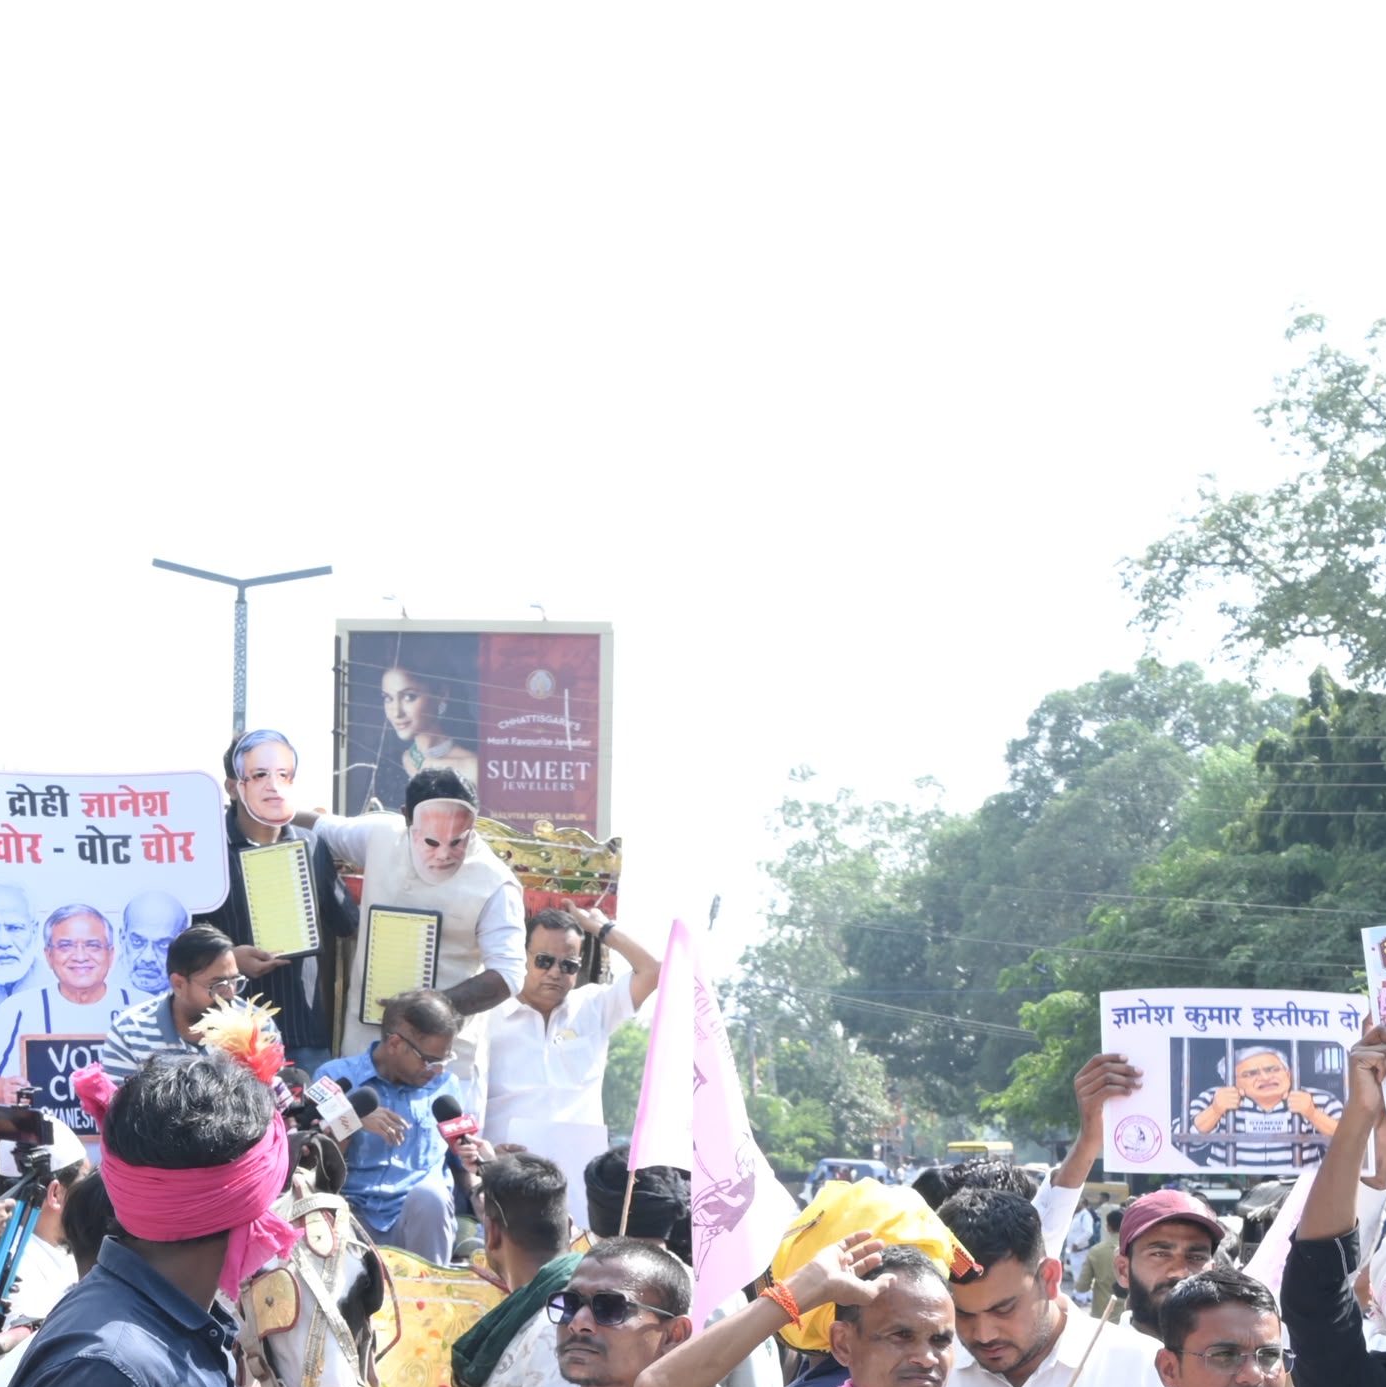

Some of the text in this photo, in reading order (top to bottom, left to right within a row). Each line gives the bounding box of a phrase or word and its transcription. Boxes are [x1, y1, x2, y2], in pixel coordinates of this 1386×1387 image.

[487, 759, 592, 781] SUMEET
[7, 783, 70, 818] द्रोही
[79, 785, 170, 818] ज्ञानेश
[502, 781, 575, 792] JEWELLERS
[75, 825, 132, 865] वोट
[140, 824, 195, 864] चोर
[1112, 998, 1174, 1029] ज्ञानेश
[1184, 1006, 1242, 1032] कुमार
[1252, 1001, 1329, 1031] इस्तीफा
[1339, 1003, 1361, 1032] दो
[48, 1044, 105, 1073] VOT
